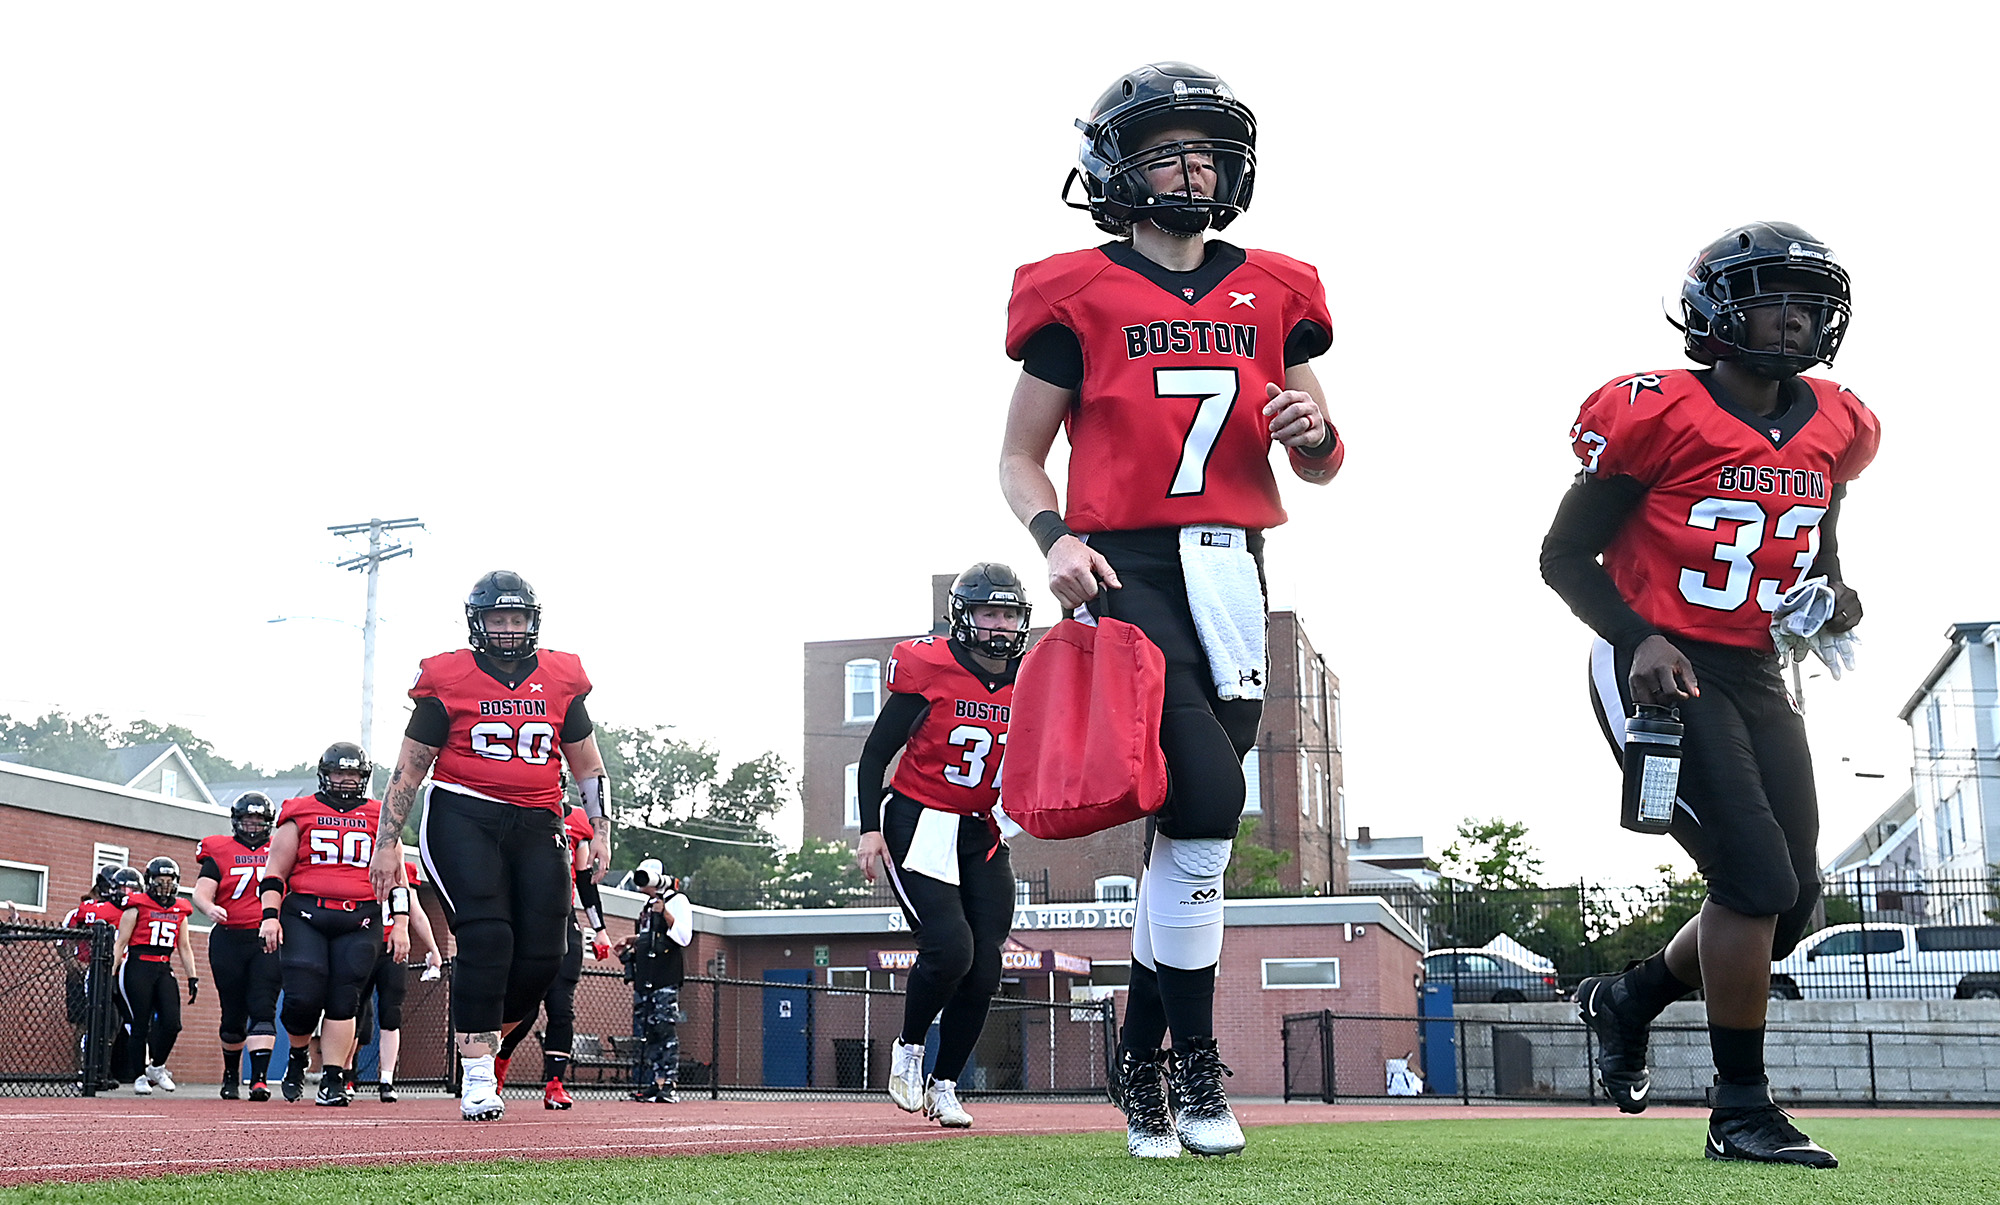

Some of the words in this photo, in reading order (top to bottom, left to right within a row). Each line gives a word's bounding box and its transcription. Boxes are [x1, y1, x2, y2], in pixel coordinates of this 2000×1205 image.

[1122, 320, 1257, 361] BOSTON
[1153, 366, 1240, 499] 7
[1717, 466, 1825, 500] BOSTON
[1678, 495, 1828, 613] 33
[480, 700, 546, 716] BOSTON
[955, 699, 1011, 723] BOSTO
[470, 721, 554, 765] 60
[317, 816, 367, 829] BOSTON
[310, 829, 372, 868] 50
[148, 921, 177, 948] 15
[1036, 910, 1100, 929] FIELD
